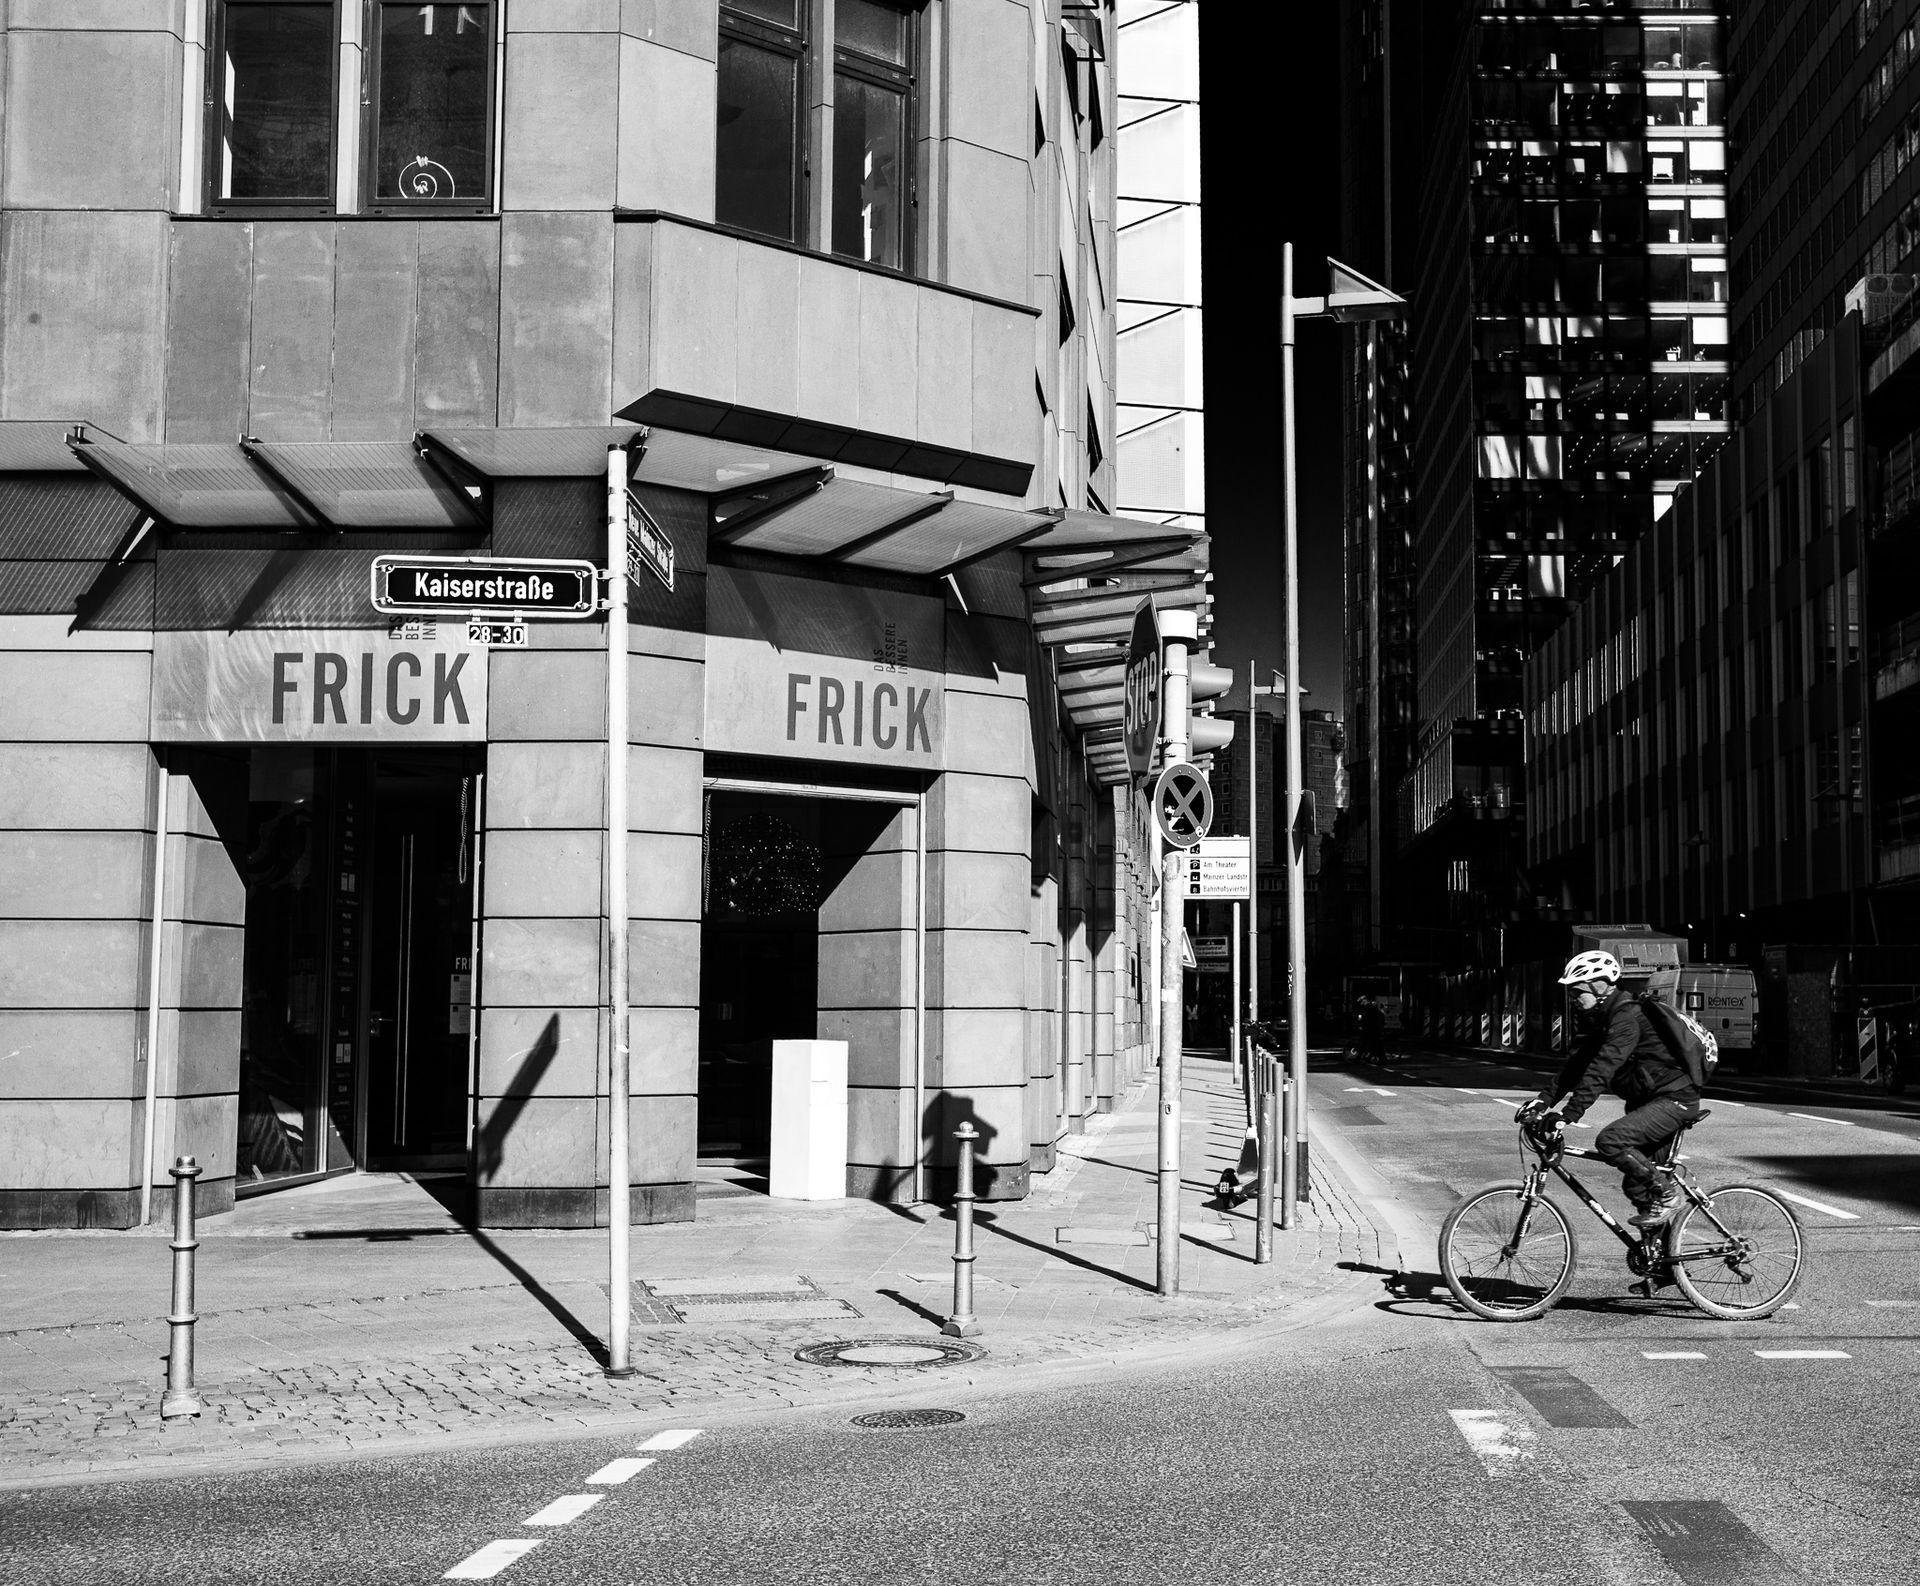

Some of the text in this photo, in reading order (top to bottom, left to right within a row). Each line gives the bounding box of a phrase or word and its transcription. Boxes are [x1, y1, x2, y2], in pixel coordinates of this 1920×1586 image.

[415, 572, 554, 600] Kaiserstraße
[388, 615, 403, 640] DAS
[469, 625, 524, 644] 28-30
[873, 649, 884, 672] DAS
[885, 622, 896, 673] BESSERE
[897, 639, 908, 674] INNEN
[272, 652, 470, 725] FRICK
[1126, 651, 1157, 735] STOP
[786, 672, 932, 753] FRICK
[1215, 860, 1237, 868] Theater
[455, 957, 471, 970] FRI
